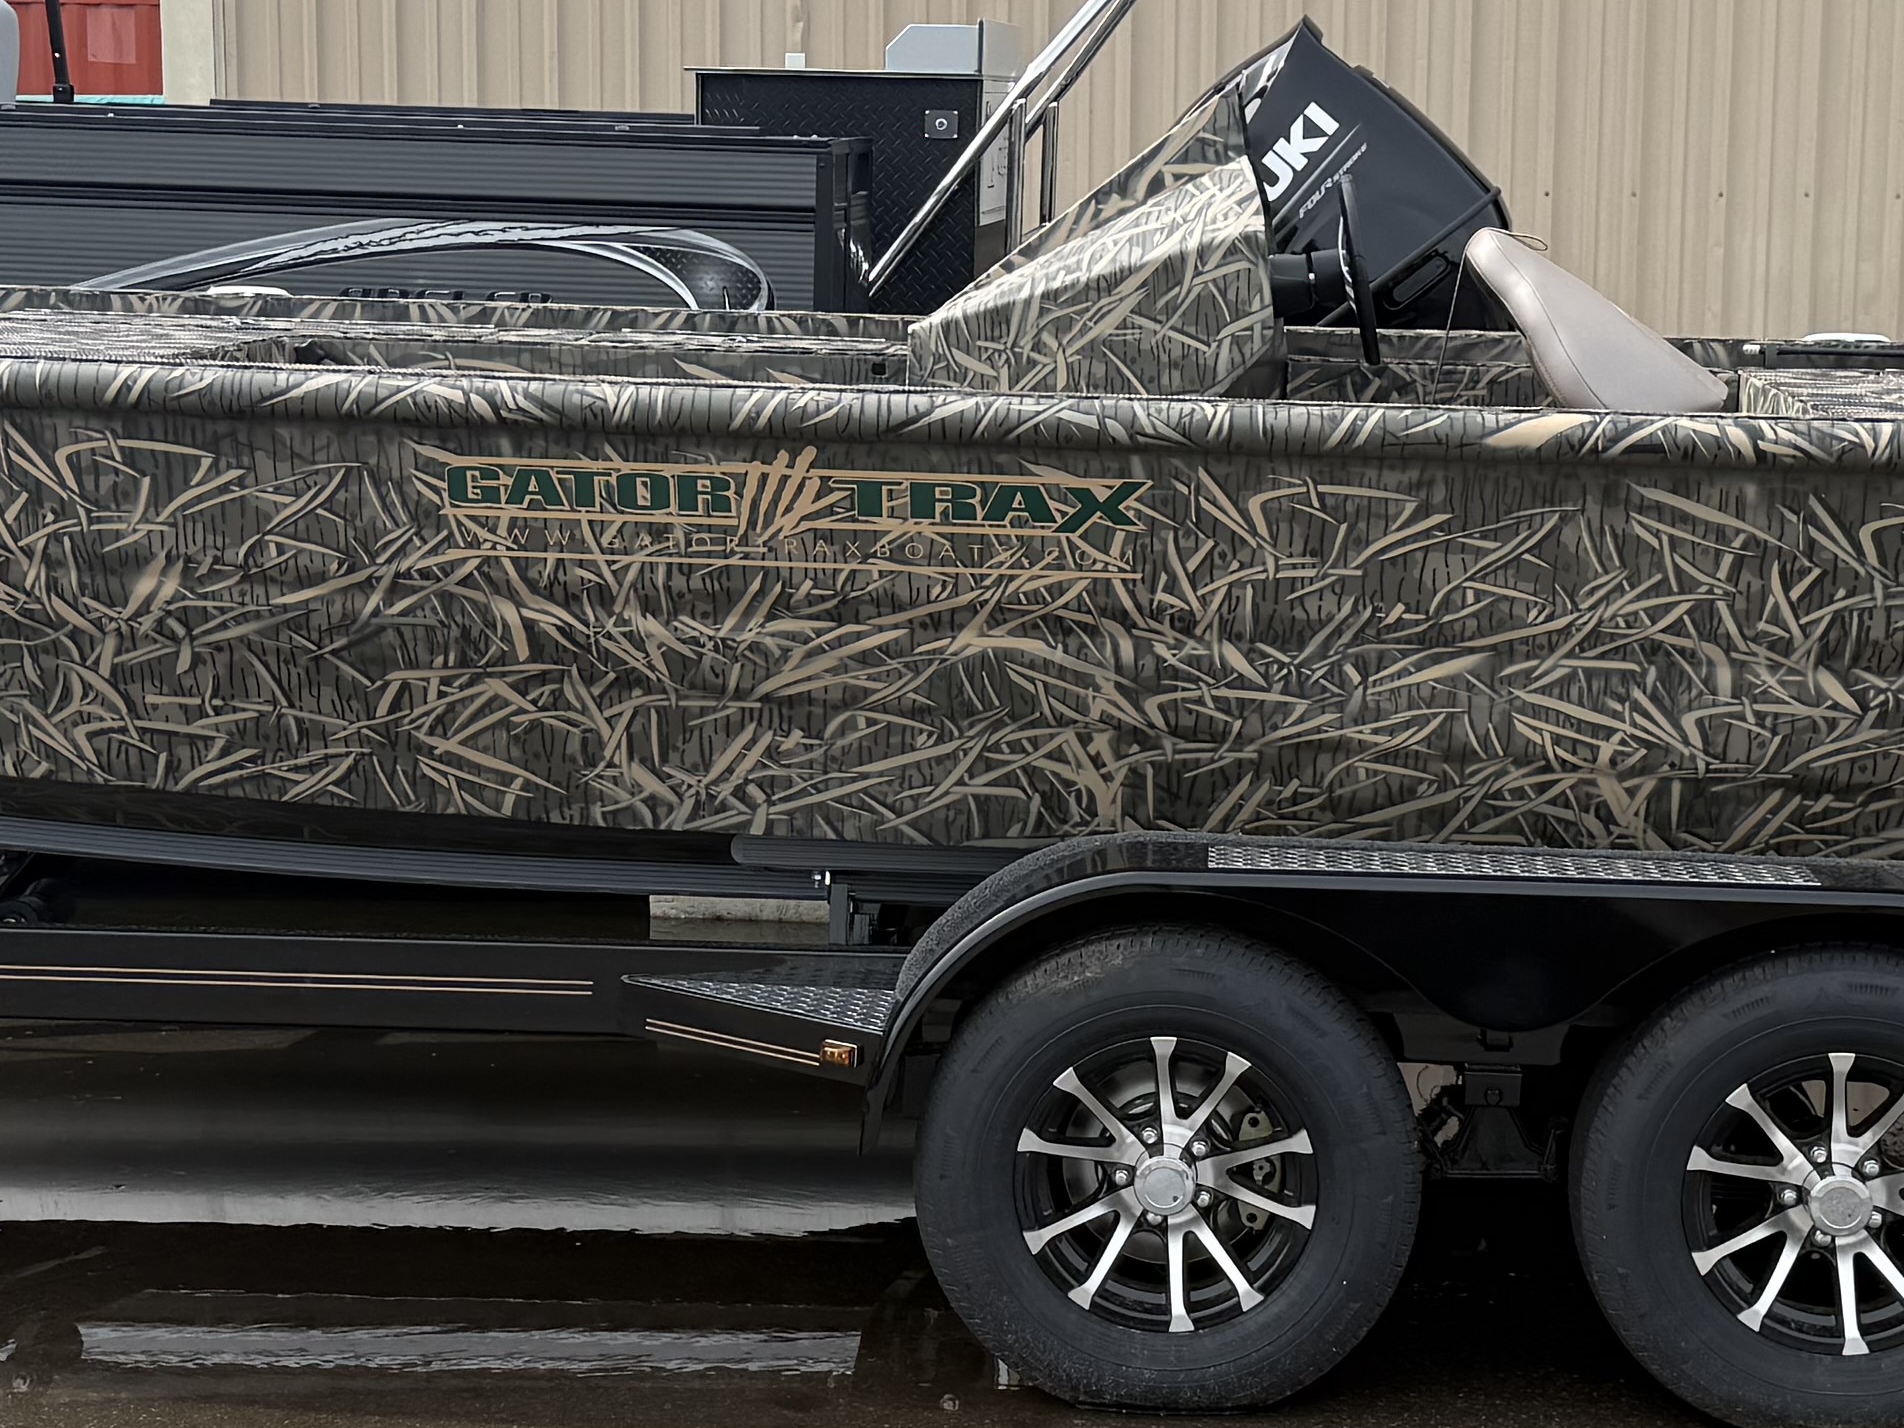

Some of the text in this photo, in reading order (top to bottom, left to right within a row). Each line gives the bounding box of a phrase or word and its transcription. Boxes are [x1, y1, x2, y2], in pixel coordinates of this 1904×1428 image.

[1261, 101, 1341, 202] UKI
[445, 464, 1154, 535] GATOR TRAX
